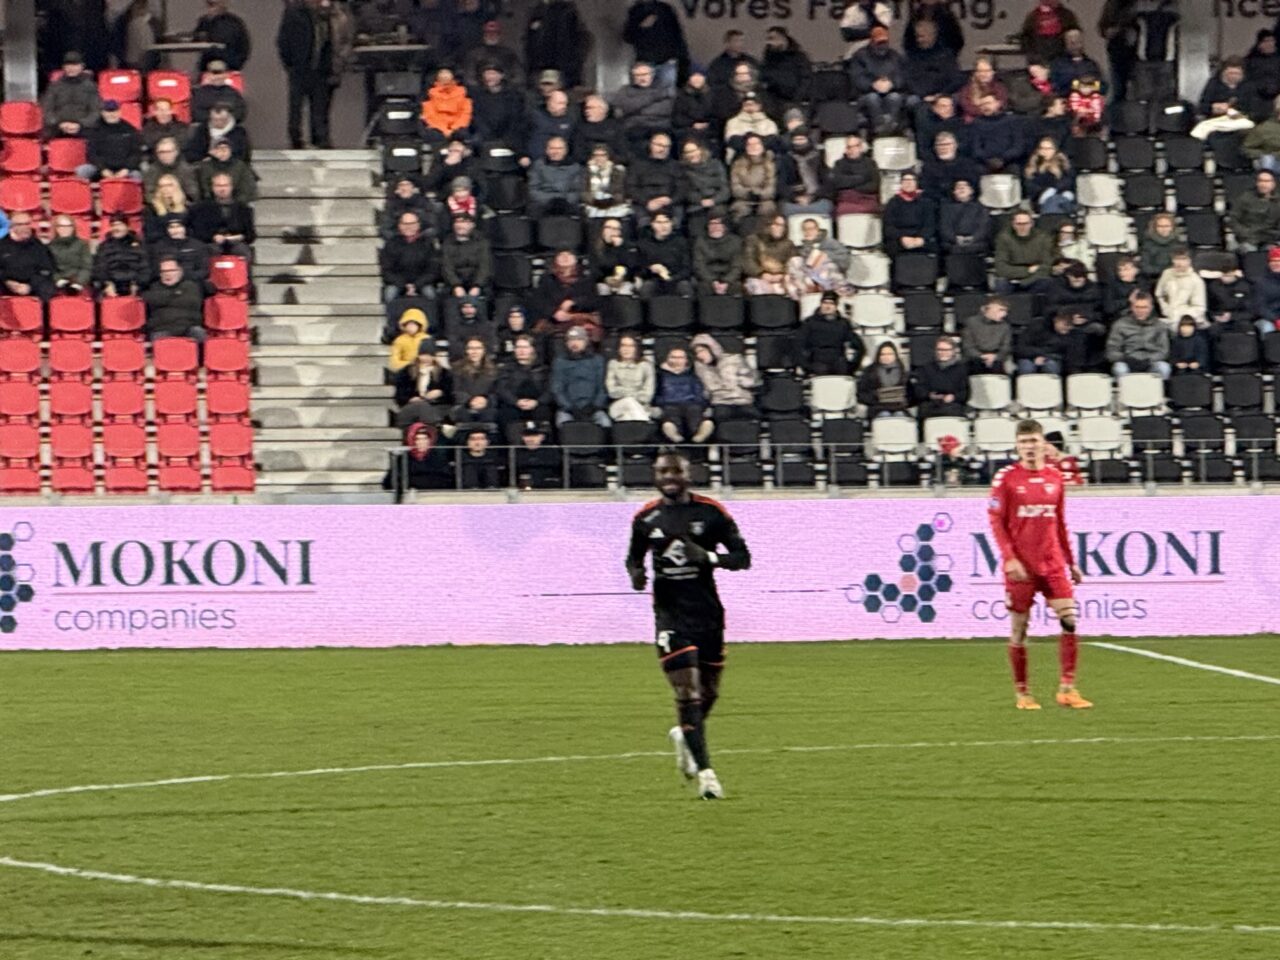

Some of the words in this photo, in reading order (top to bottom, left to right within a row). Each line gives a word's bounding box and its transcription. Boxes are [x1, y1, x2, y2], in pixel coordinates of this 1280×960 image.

[680, 0, 792, 19] Vores
[52, 539, 315, 587] MOKONI
[969, 530, 1225, 577] MKONI
[54, 602, 237, 635] companies
